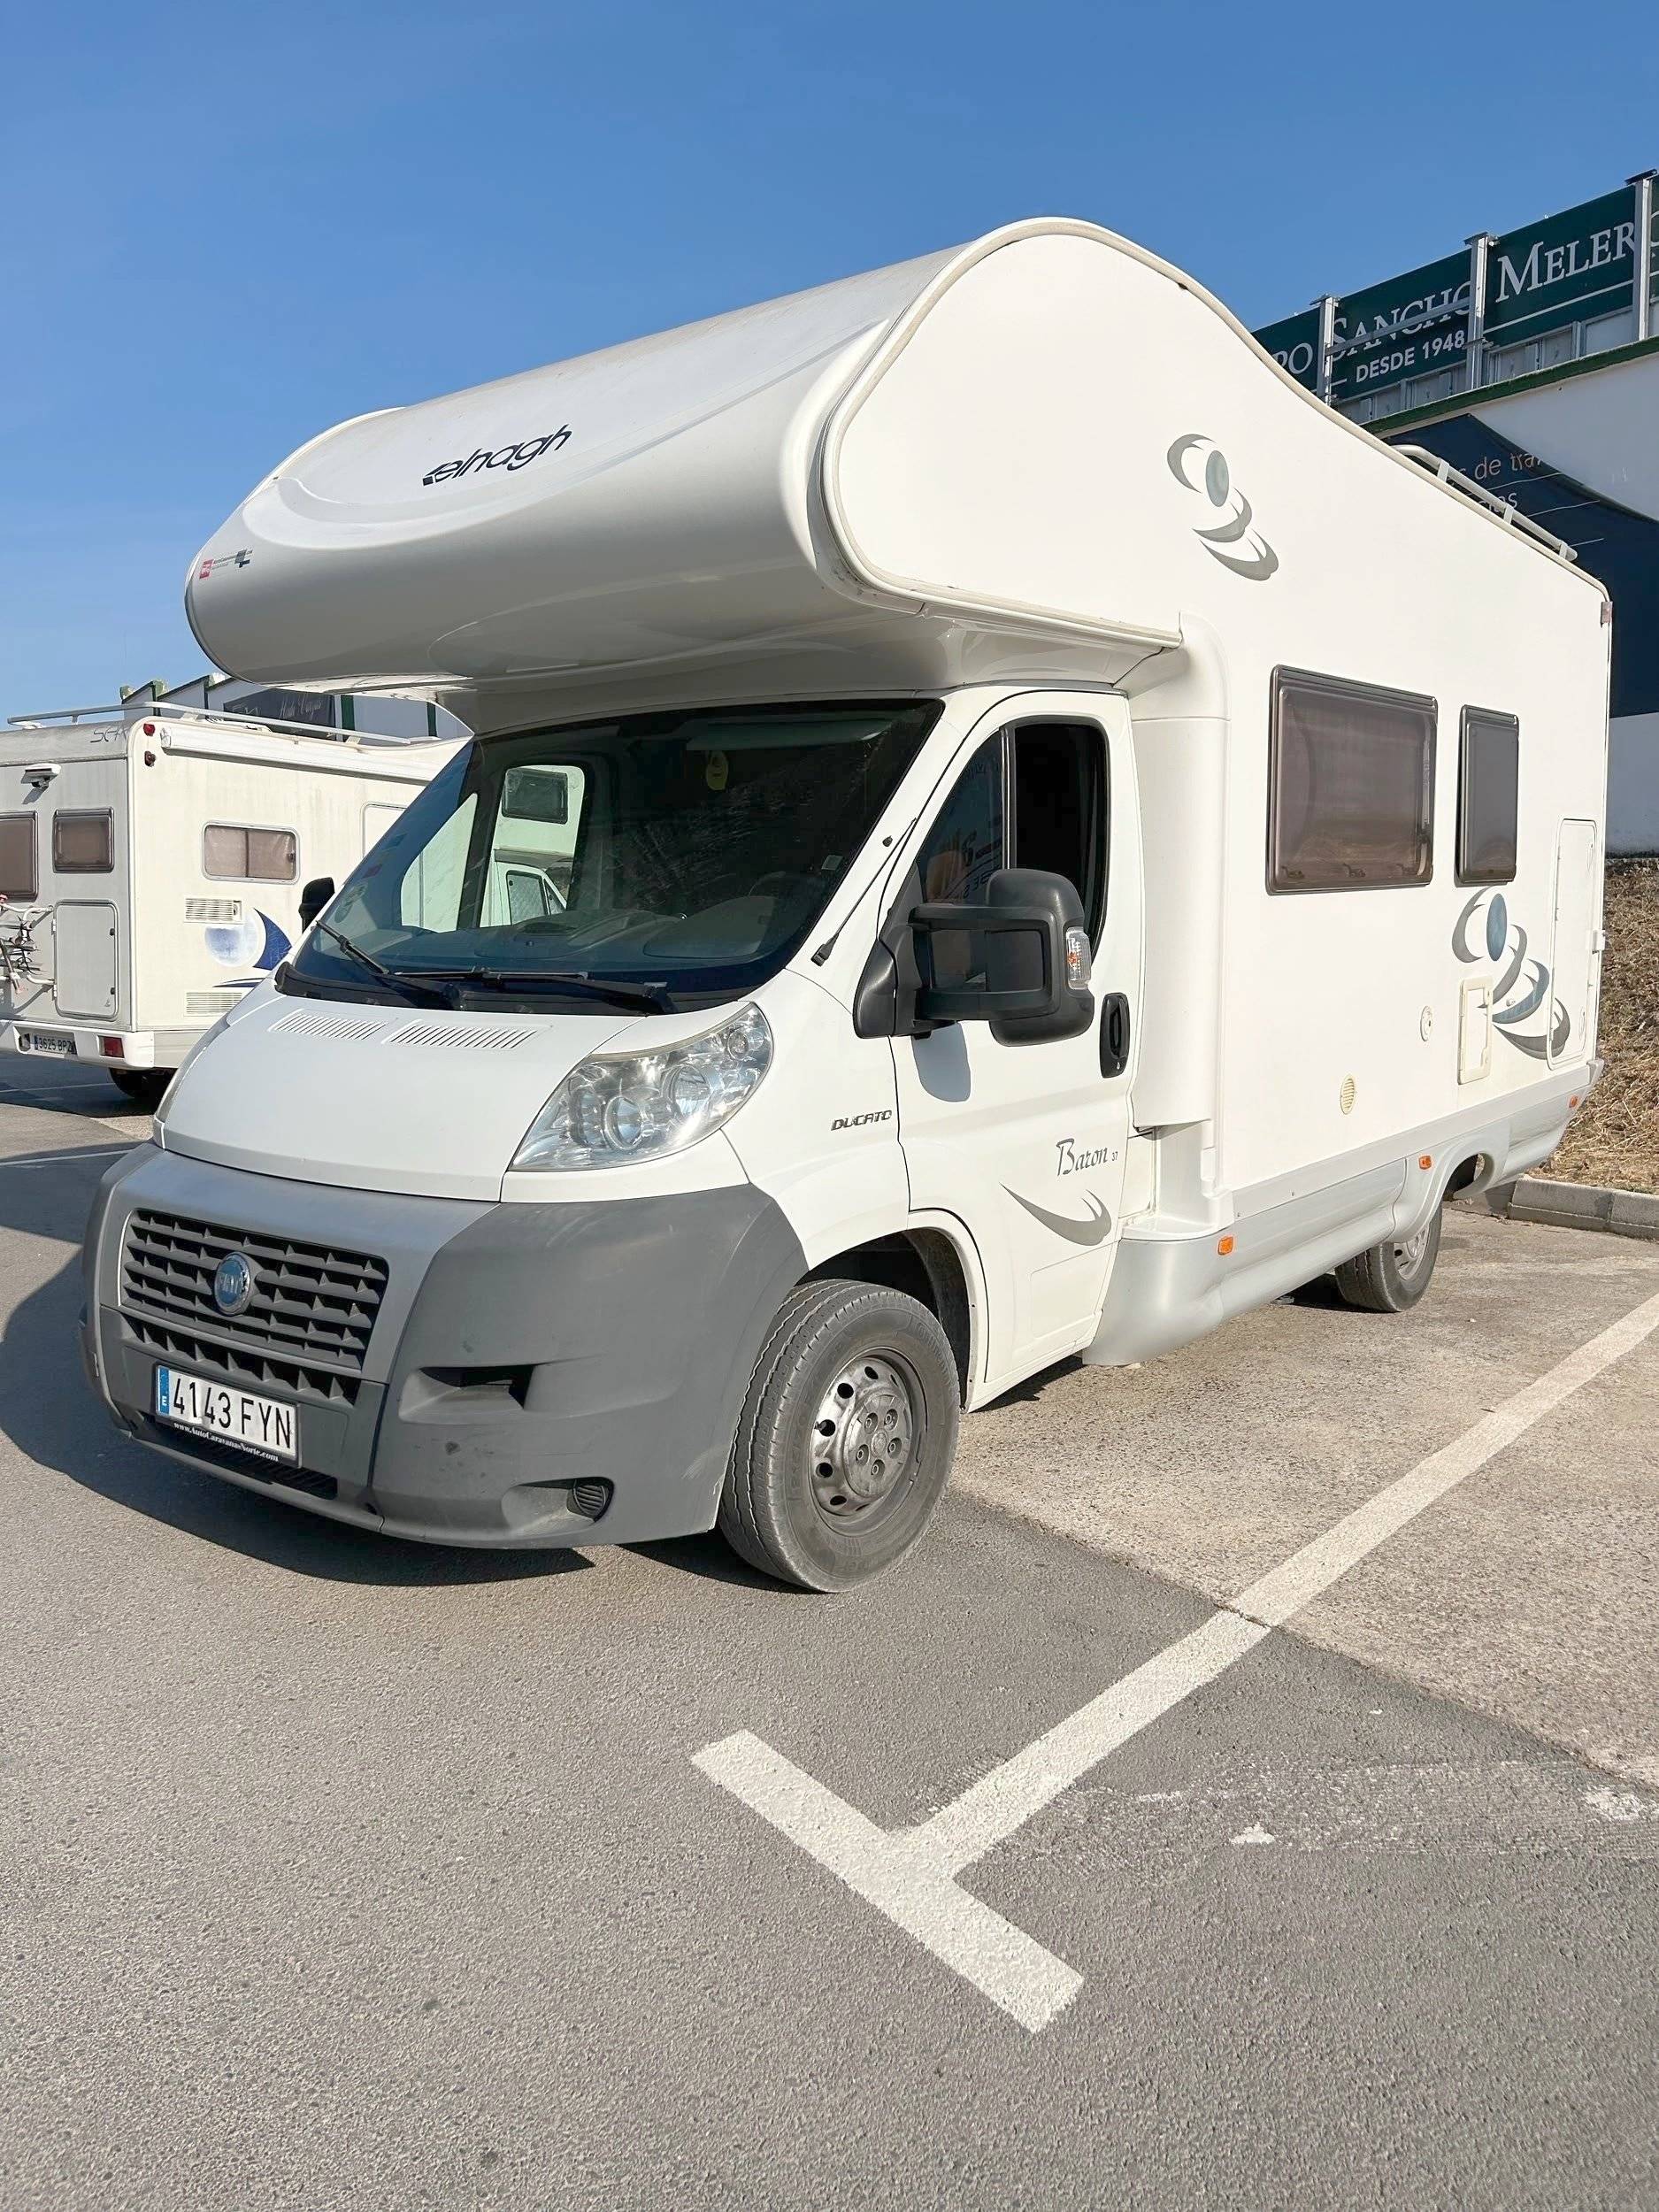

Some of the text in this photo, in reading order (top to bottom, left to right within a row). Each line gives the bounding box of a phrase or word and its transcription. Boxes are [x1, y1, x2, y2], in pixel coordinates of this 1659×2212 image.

[1495, 221, 1635, 303] MELER
[1356, 330, 1465, 383] DESDE 1948
[423, 423, 572, 487] elnagh
[1474, 456, 1502, 480] de
[1509, 452, 1542, 471] tra
[831, 1110, 893, 1132] DUCATO
[1056, 1138, 1108, 1177] Baron
[161, 1395, 167, 1406] E
[173, 1378, 291, 1449] 4143 FYN
